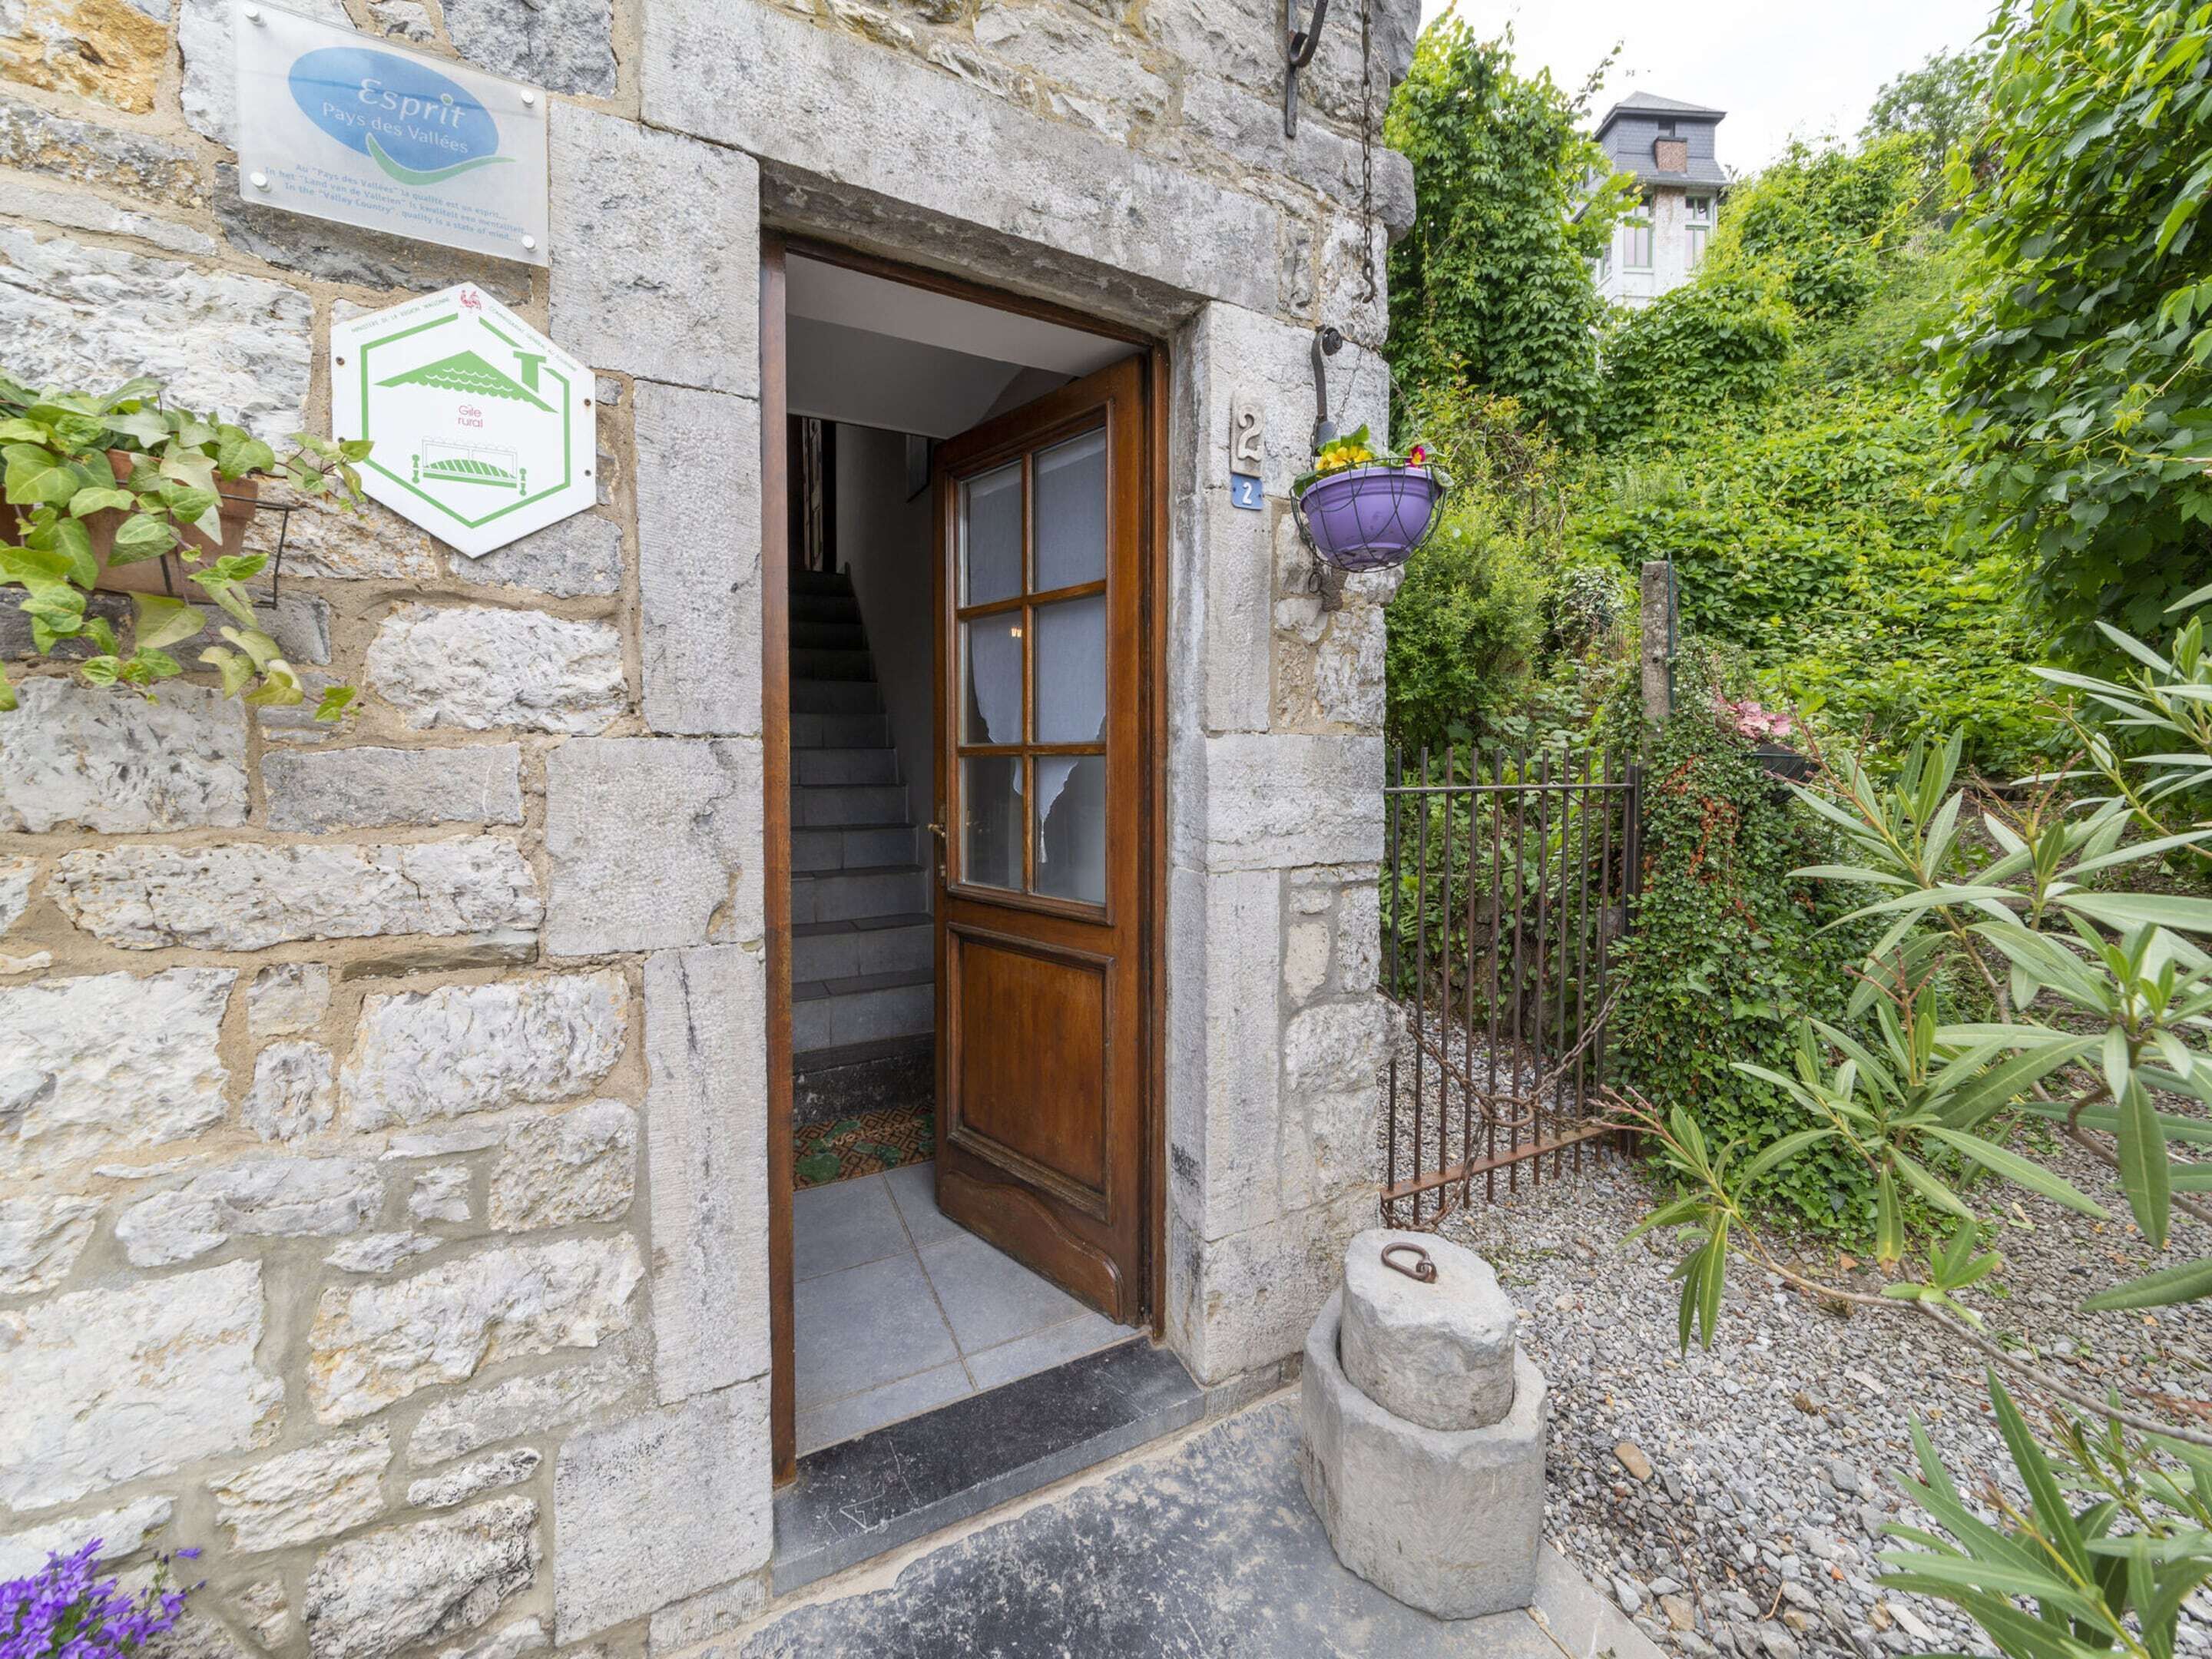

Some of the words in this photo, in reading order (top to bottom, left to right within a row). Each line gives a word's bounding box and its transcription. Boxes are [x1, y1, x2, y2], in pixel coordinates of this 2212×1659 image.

[323, 101, 366, 126] Pays
[372, 117, 403, 137] des
[408, 124, 468, 154] Vallées
[359, 78, 466, 129] Esprit
[458, 417, 483, 429] rural
[1237, 404, 1263, 462] 2
[1242, 482, 1253, 505] 2
